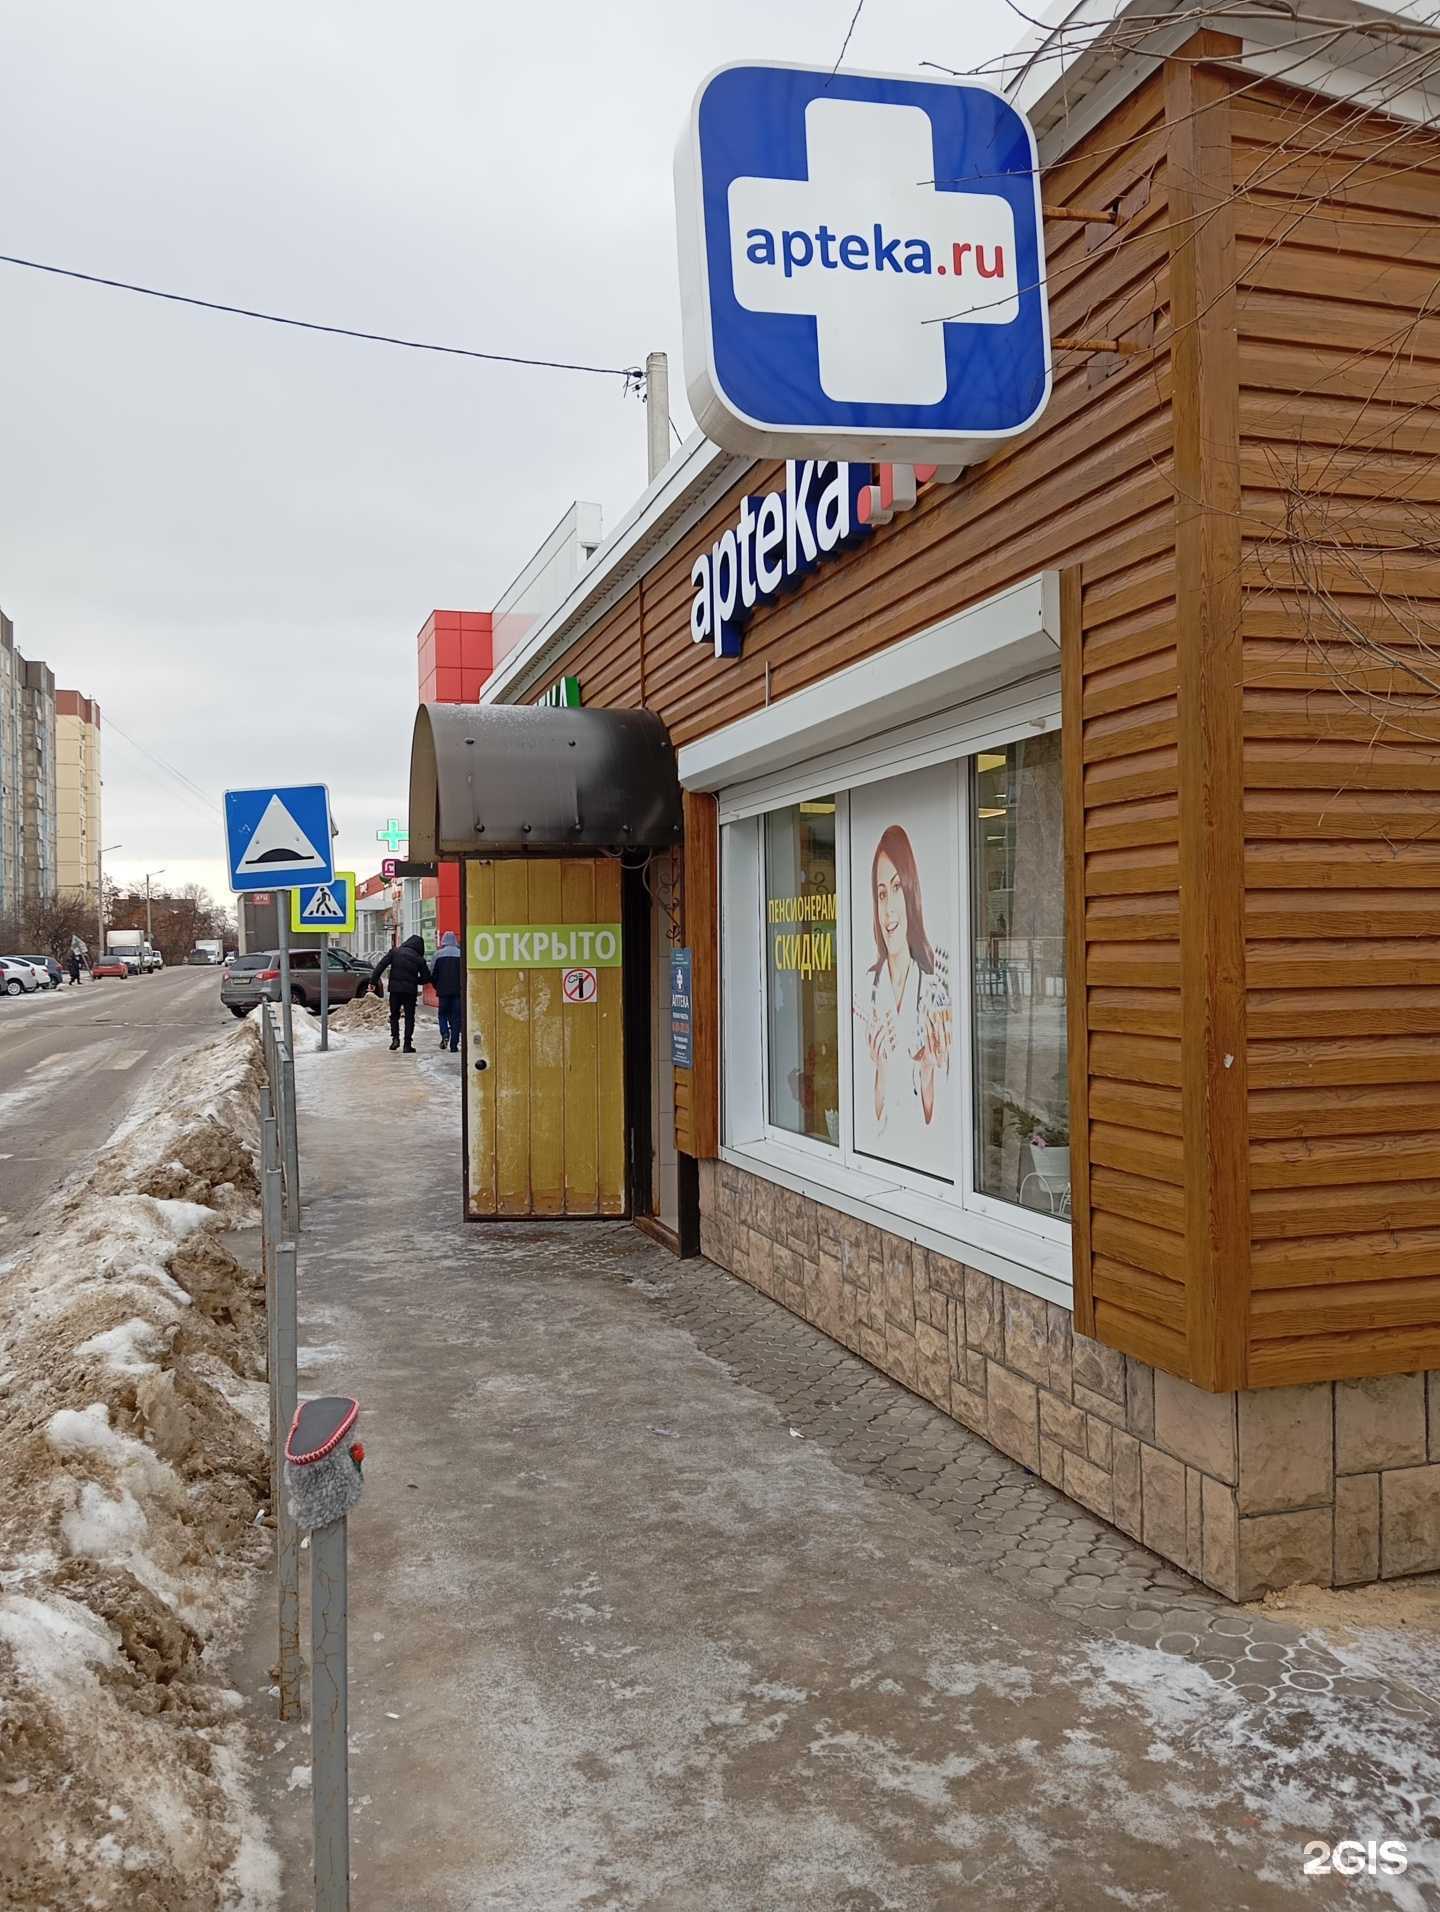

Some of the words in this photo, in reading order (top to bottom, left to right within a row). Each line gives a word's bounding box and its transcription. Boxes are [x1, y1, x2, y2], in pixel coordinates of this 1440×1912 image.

[745, 223, 1005, 278] apteka.ru
[690, 459, 938, 658] apteka.
[768, 894, 838, 923] ПЕНСИОНЕРАМ
[473, 930, 617, 962] ОТКРЫТО
[775, 932, 832, 980] СКИДКИ
